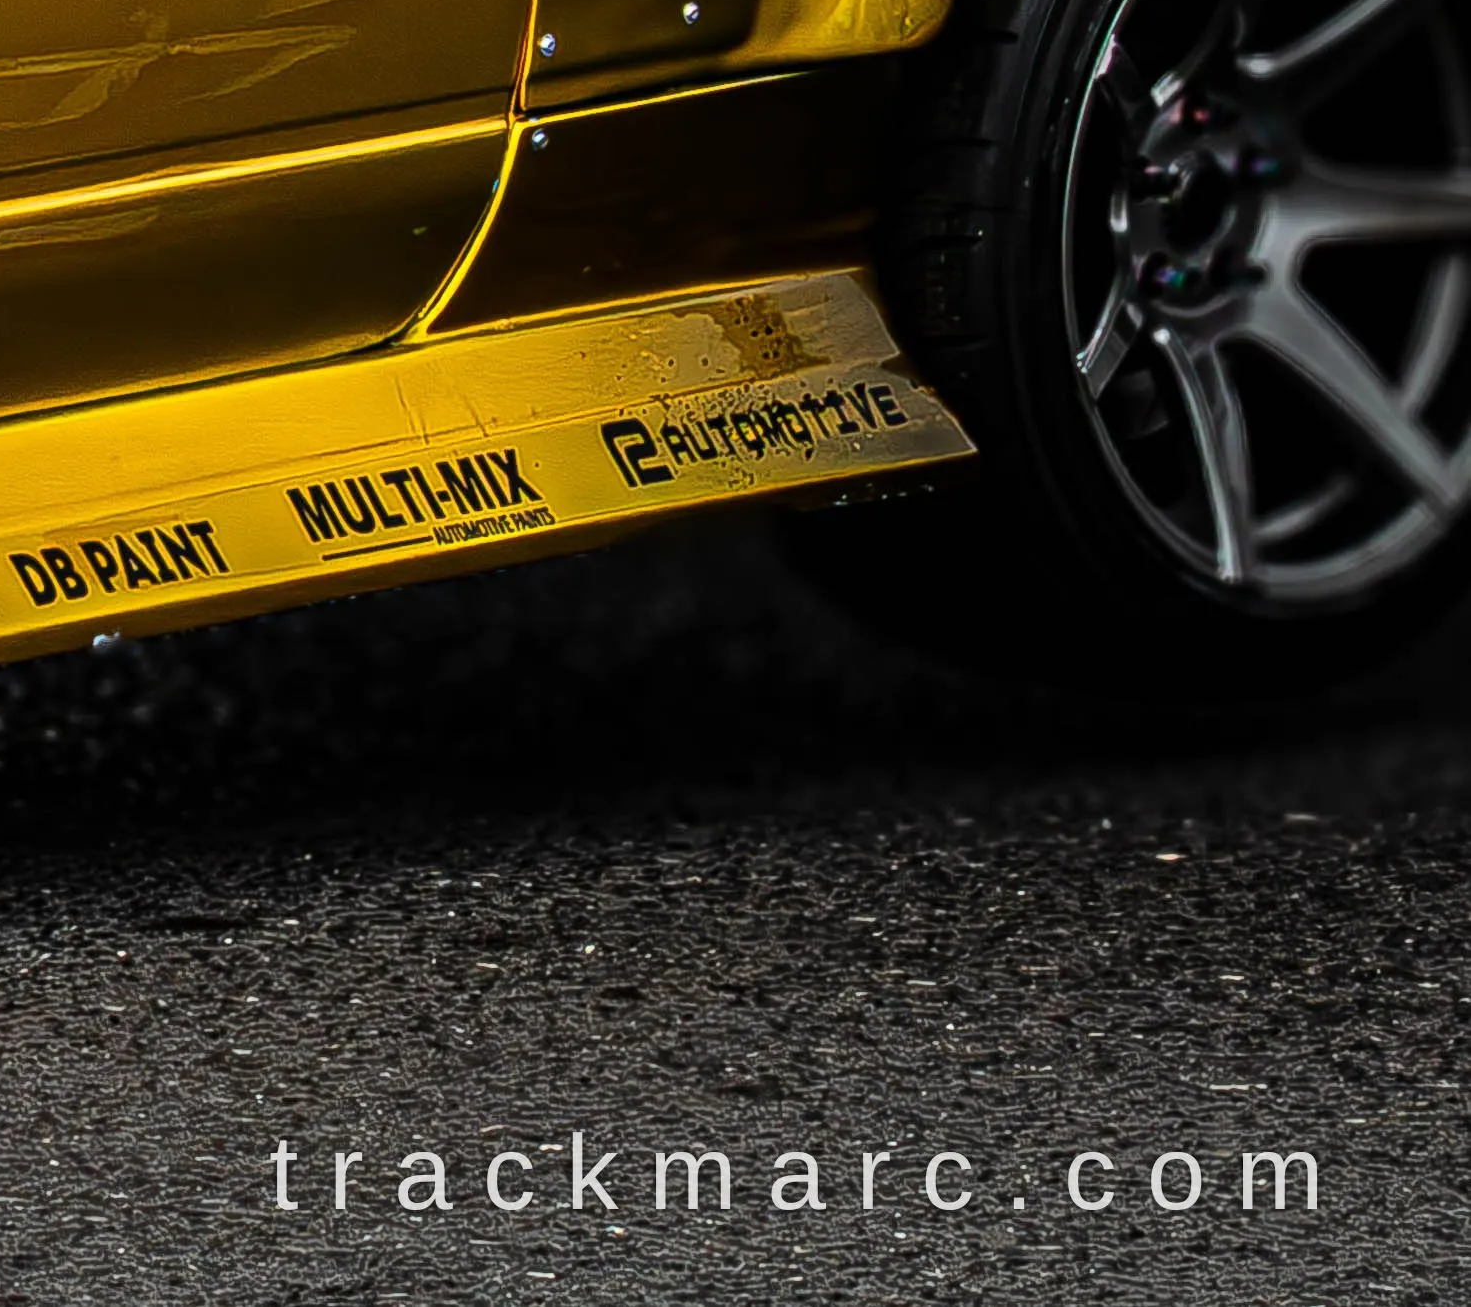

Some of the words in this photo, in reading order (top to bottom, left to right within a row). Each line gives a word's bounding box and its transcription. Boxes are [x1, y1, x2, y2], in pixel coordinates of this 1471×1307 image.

[660, 382, 910, 465] AUTOMOTIVE
[286, 448, 543, 543] MULTI-MIX
[9, 546, 88, 607] DB
[83, 520, 231, 594] PAINT
